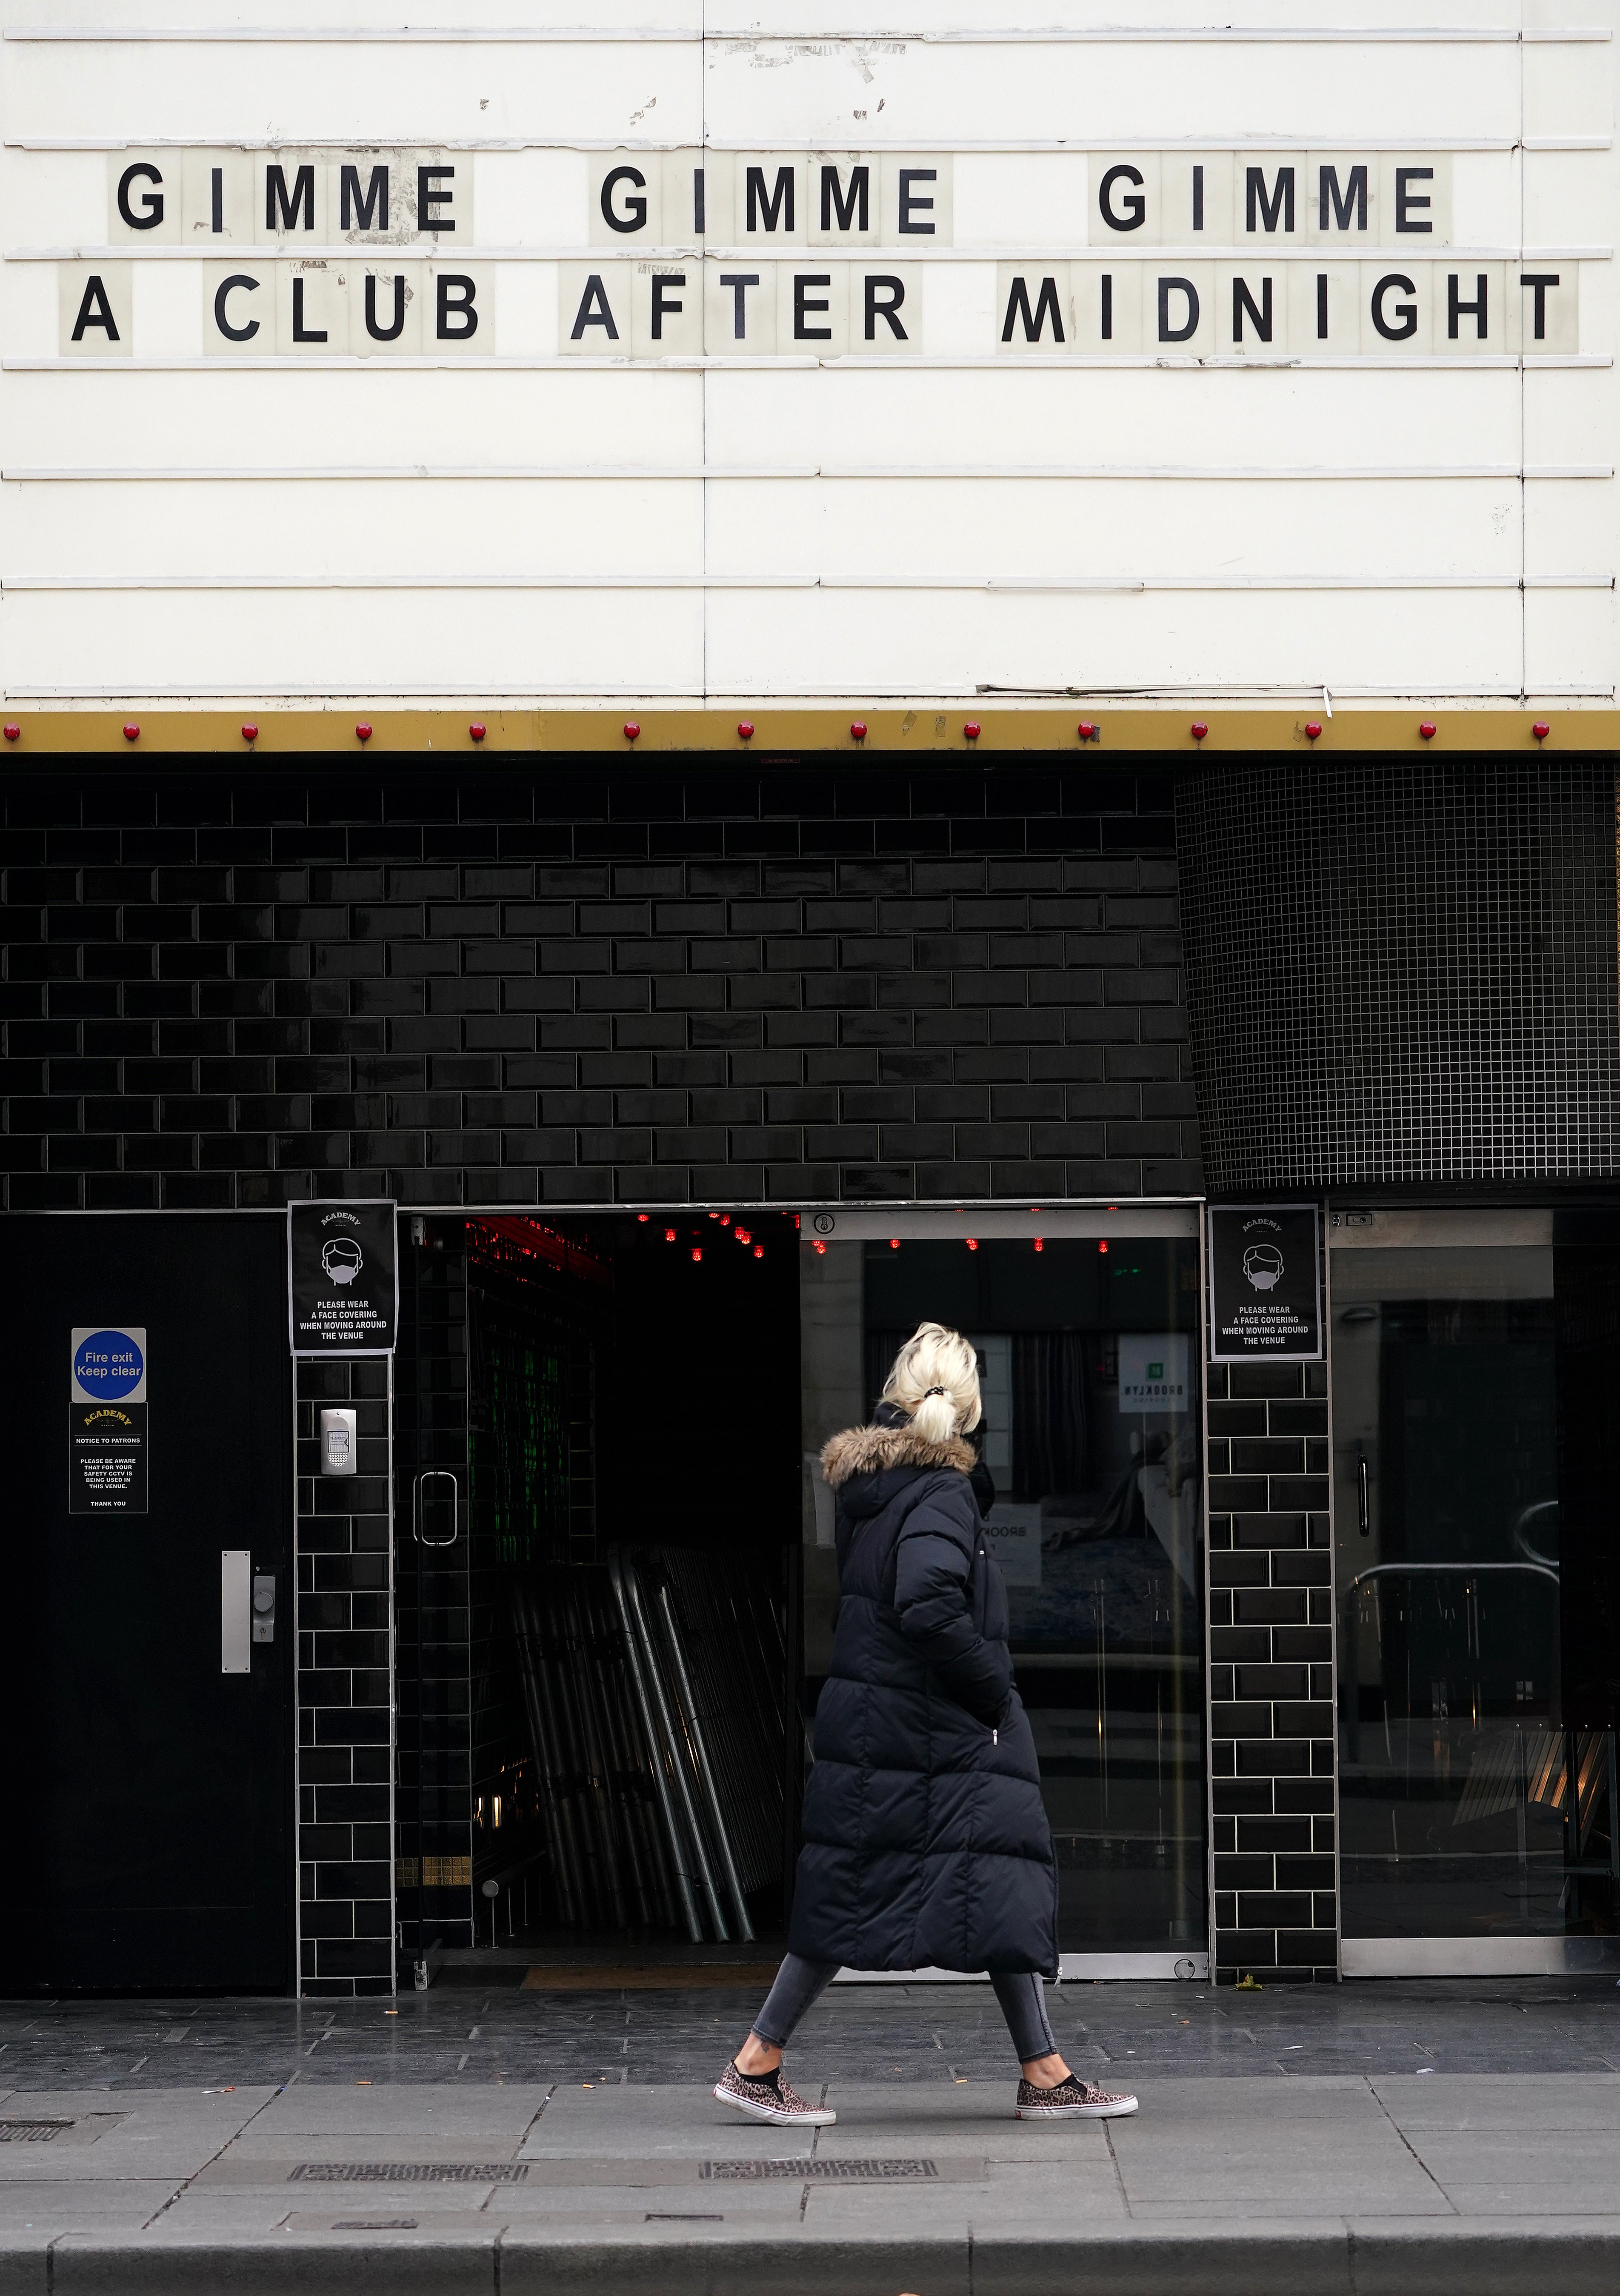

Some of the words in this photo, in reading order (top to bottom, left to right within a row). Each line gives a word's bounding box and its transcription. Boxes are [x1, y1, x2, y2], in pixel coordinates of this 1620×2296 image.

[118, 163, 455, 232] GIMME
[601, 166, 936, 234] GIMME
[1100, 165, 1433, 232] GIMME
[71, 276, 120, 340] A
[215, 275, 477, 342] CLUB
[571, 275, 908, 339] AFTER
[1002, 274, 1559, 342] MIDNIGHT
[321, 1212, 361, 1226] ACADEMY
[1243, 1218, 1282, 1232] ACADEMY
[85, 1352, 109, 1363] Fire
[111, 1352, 134, 1363] exit
[77, 1365, 109, 1379] Keep
[111, 1365, 141, 1376] clear
[83, 1409, 133, 1426] ACADEMY
